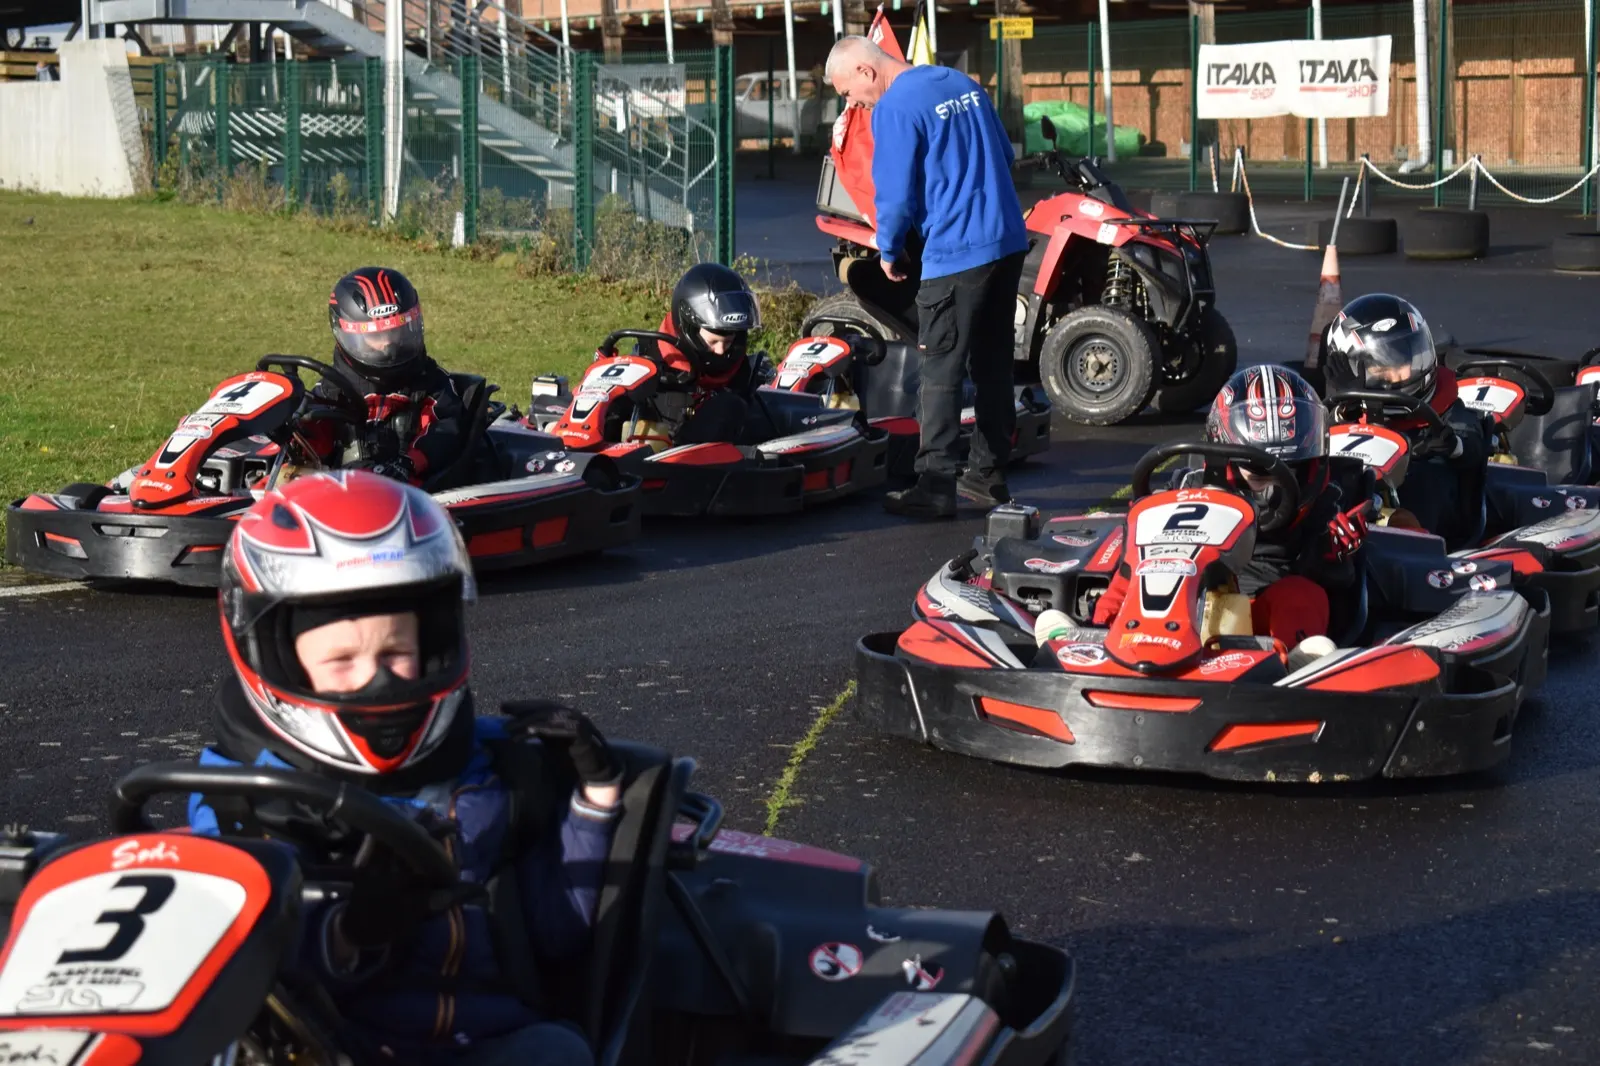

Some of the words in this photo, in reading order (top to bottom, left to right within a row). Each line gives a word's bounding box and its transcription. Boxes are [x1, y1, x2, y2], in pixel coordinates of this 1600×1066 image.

[1207, 62, 1276, 85] ITAKA
[1299, 58, 1379, 83] ITAKA
[1250, 87, 1276, 100] SHOP
[1347, 84, 1378, 98] SHOP
[935, 91, 980, 120] STAFF
[373, 305, 399, 315] HJC
[724, 314, 748, 323] HJC
[802, 343, 828, 355] 9
[600, 364, 630, 377] 6
[220, 381, 260, 401] 4
[1475, 386, 1490, 401] 1
[1340, 434, 1374, 451] 7
[1176, 490, 1210, 502] Sodi
[1163, 503, 1210, 530] 2
[1149, 546, 1188, 556] Sodi
[111, 840, 180, 869] Sodi
[56, 874, 177, 966] 3
